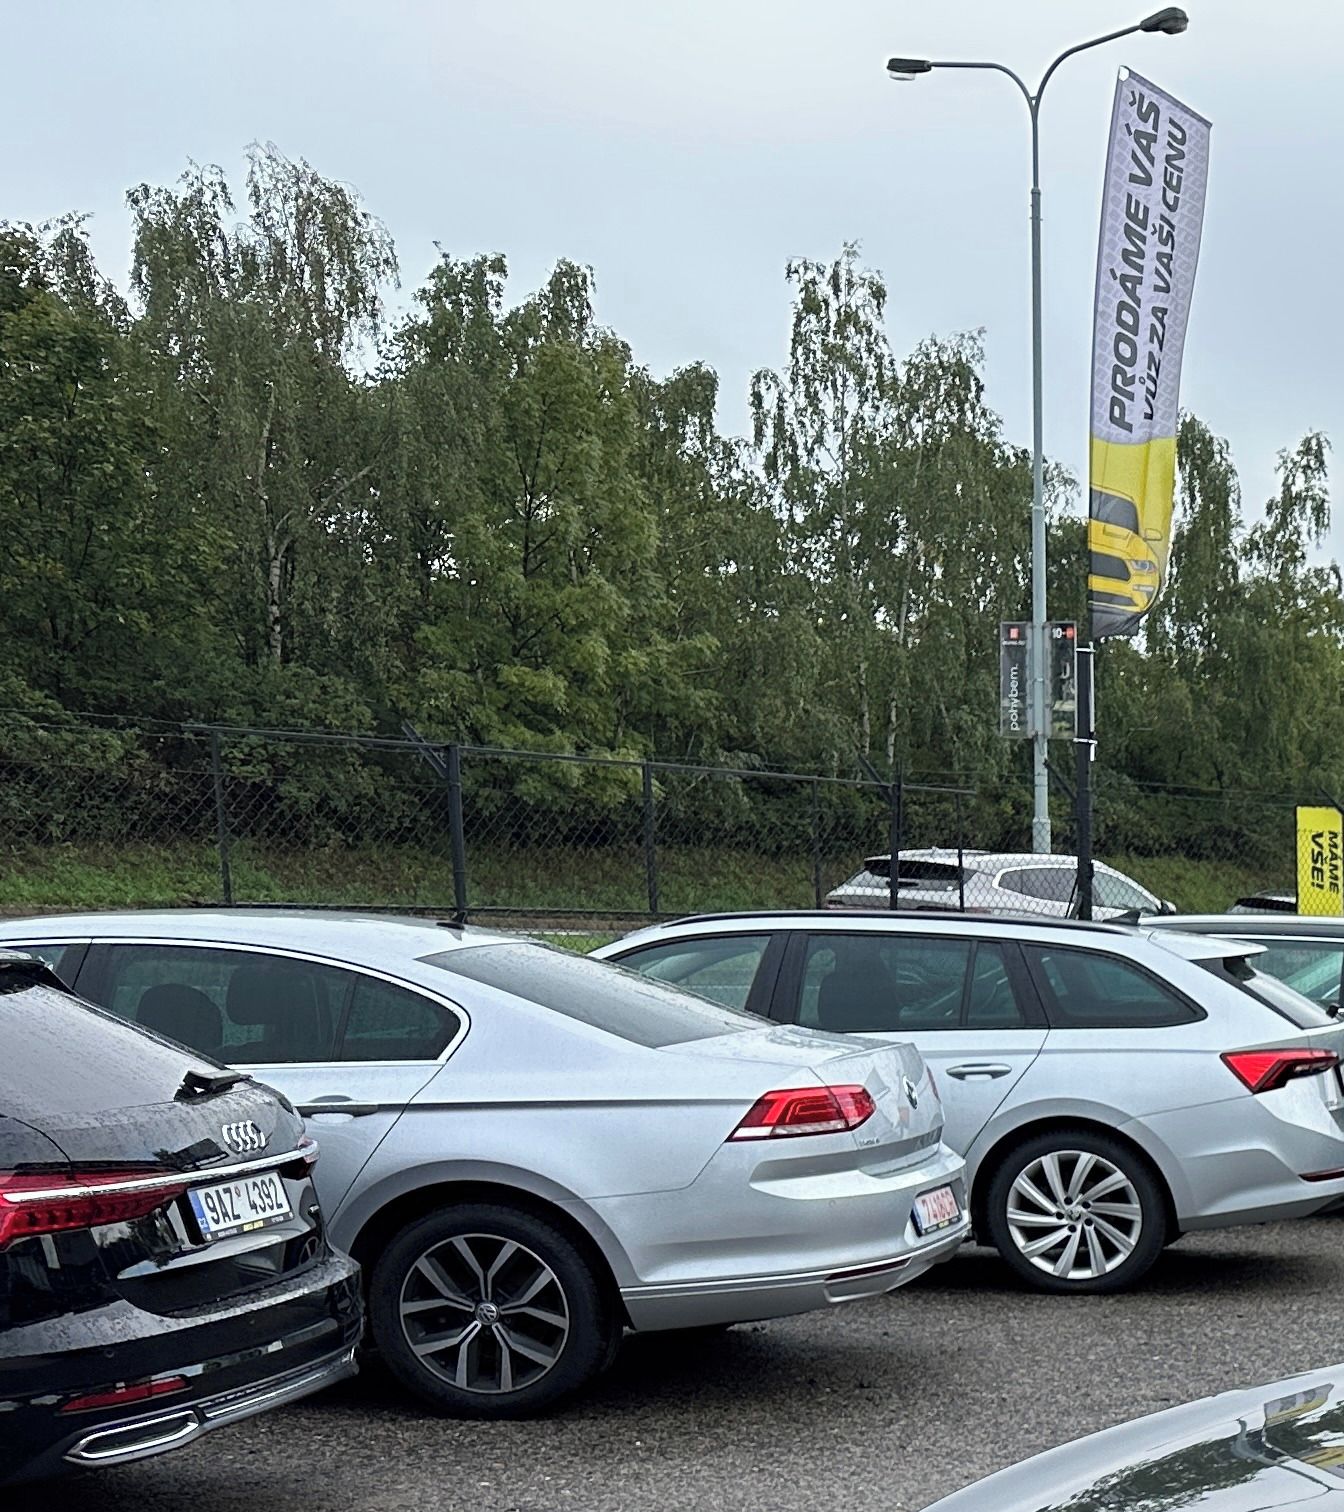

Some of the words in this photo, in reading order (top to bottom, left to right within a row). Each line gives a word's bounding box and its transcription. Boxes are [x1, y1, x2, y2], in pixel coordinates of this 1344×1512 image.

[1125, 90, 1161, 187] VÁŠ
[1162, 117, 1187, 212] CENU
[1151, 213, 1176, 293] VAŠI
[1109, 192, 1150, 433] PRODÁME
[1149, 306, 1168, 352] ZA
[1139, 351, 1161, 420] VŮZ
[1311, 832, 1328, 890] VŠE!
[1328, 830, 1342, 894] MÁME
[204, 1186, 241, 1225] 9AZ
[245, 1177, 284, 1214] 4392
